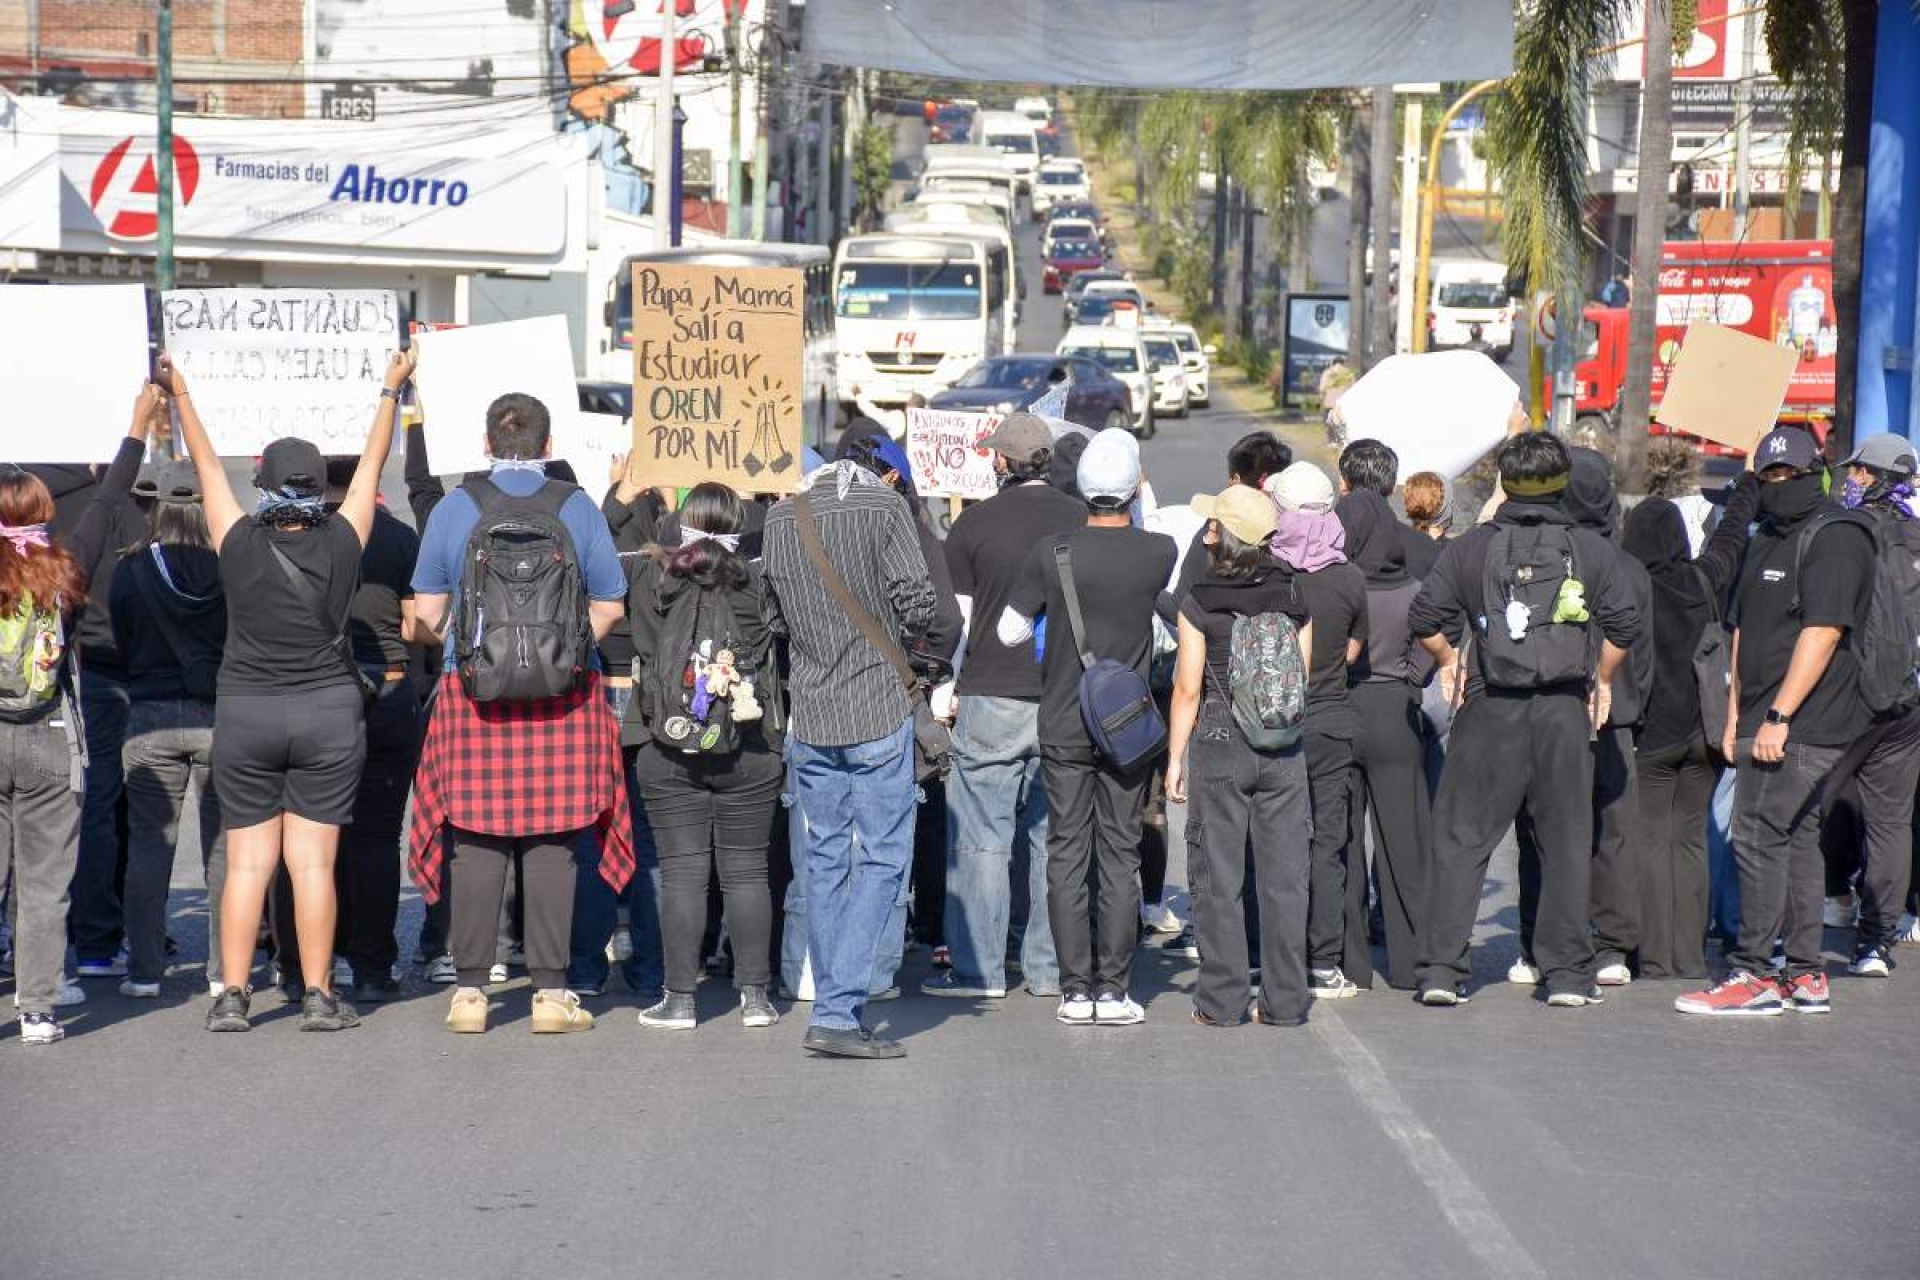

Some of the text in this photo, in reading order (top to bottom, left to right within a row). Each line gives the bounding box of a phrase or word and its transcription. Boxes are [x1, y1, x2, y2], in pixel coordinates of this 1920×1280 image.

[215, 155, 329, 183] Farmacias del
[331, 163, 469, 207] Ahorro
[714, 274, 795, 308] Mamá
[672, 311, 745, 343] Salí a
[894, 331, 917, 348] 14
[639, 340, 762, 382] Estudiar
[650, 385, 722, 422] OREN
[648, 419, 743, 470] POR MÍ
[935, 446, 966, 469] NO
